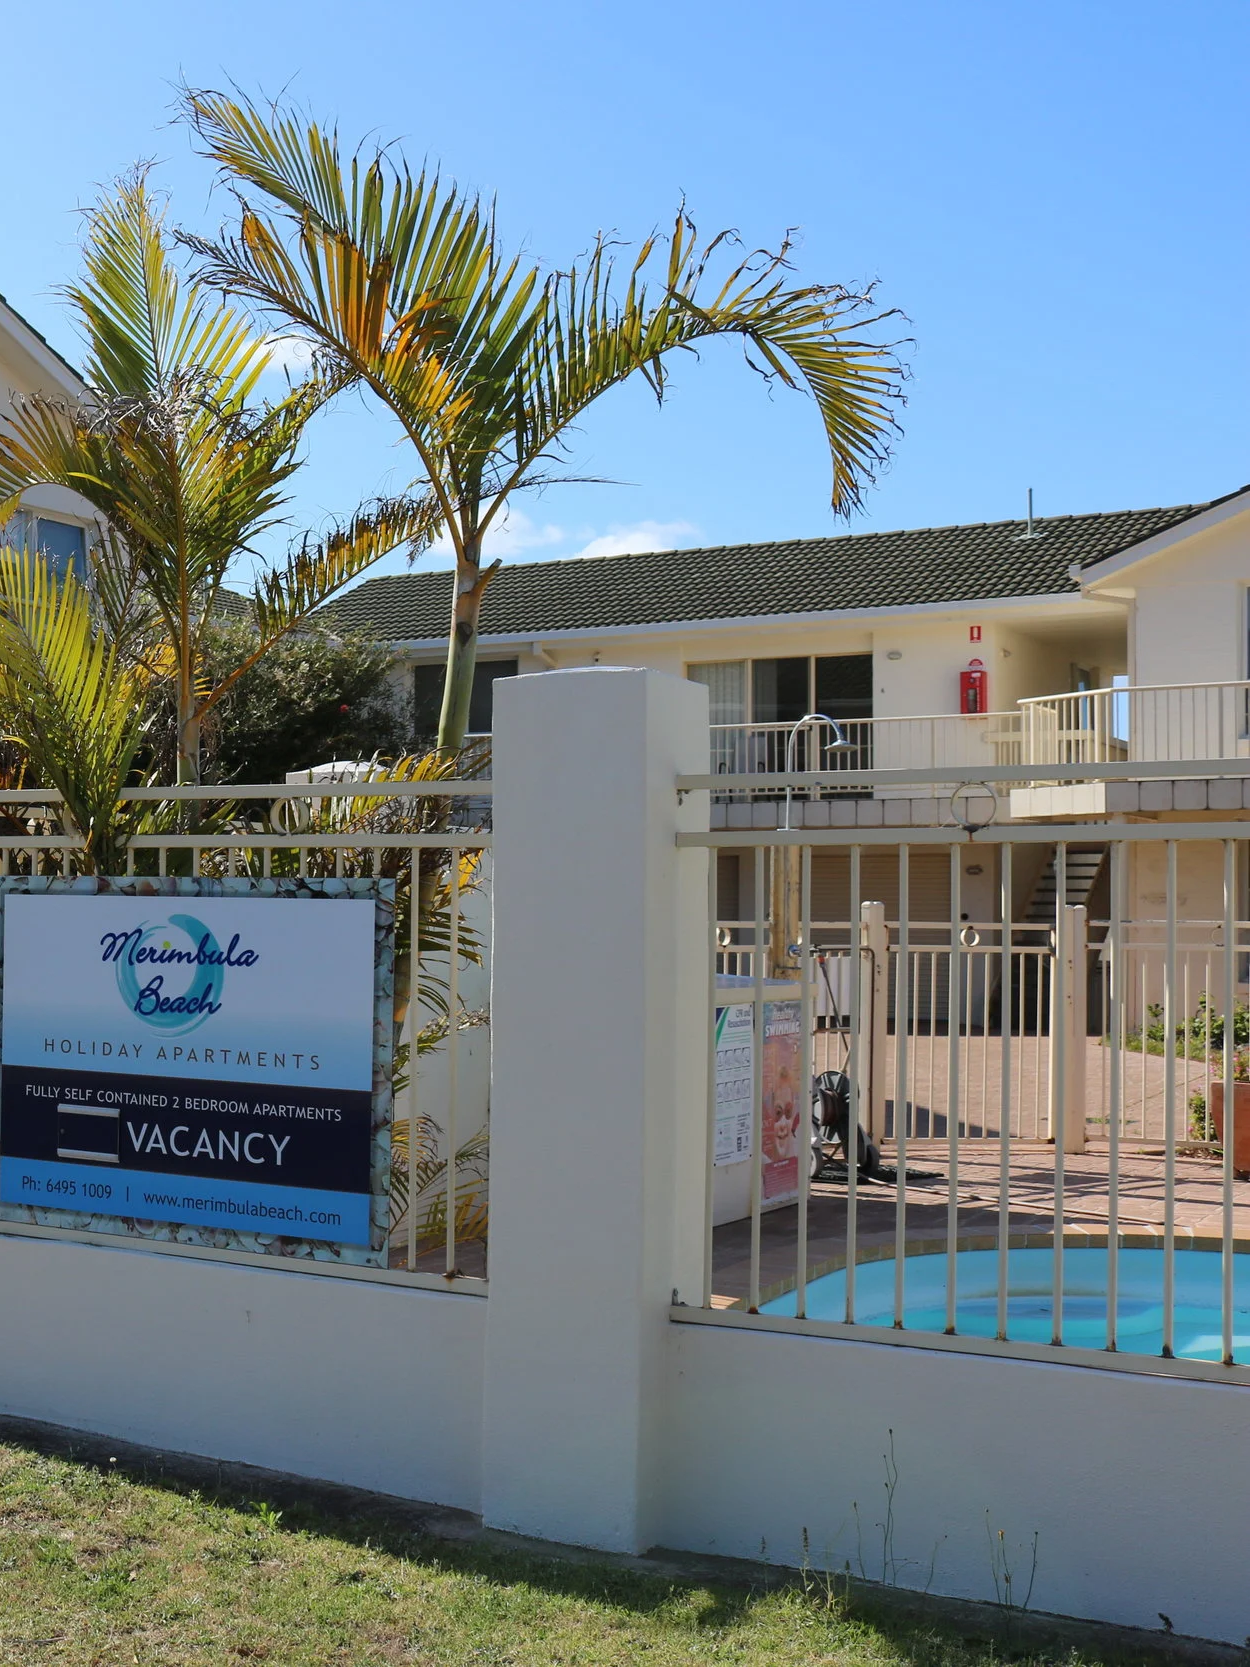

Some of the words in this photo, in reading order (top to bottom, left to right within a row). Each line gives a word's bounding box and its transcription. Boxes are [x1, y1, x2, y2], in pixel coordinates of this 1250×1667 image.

[100, 928, 259, 967] Merimbula
[134, 975, 222, 1016] Beach
[45, 1038, 143, 1058] HOLIDAY
[156, 1046, 320, 1071] APARTMENTS
[25, 1085, 60, 1098] FULLY
[64, 1087, 93, 1101] SELF
[97, 1090, 167, 1108] CONTAINED
[172, 1096, 180, 1109] 2
[185, 1097, 249, 1115] BEDROOM
[253, 1103, 342, 1122] APARTMENTS
[126, 1121, 291, 1165] VACANCY
[22, 1175, 41, 1191] Ph:
[46, 1178, 76, 1195] 6495
[82, 1182, 112, 1199] 1009
[143, 1191, 341, 1226] www.merimbulabeach.com
